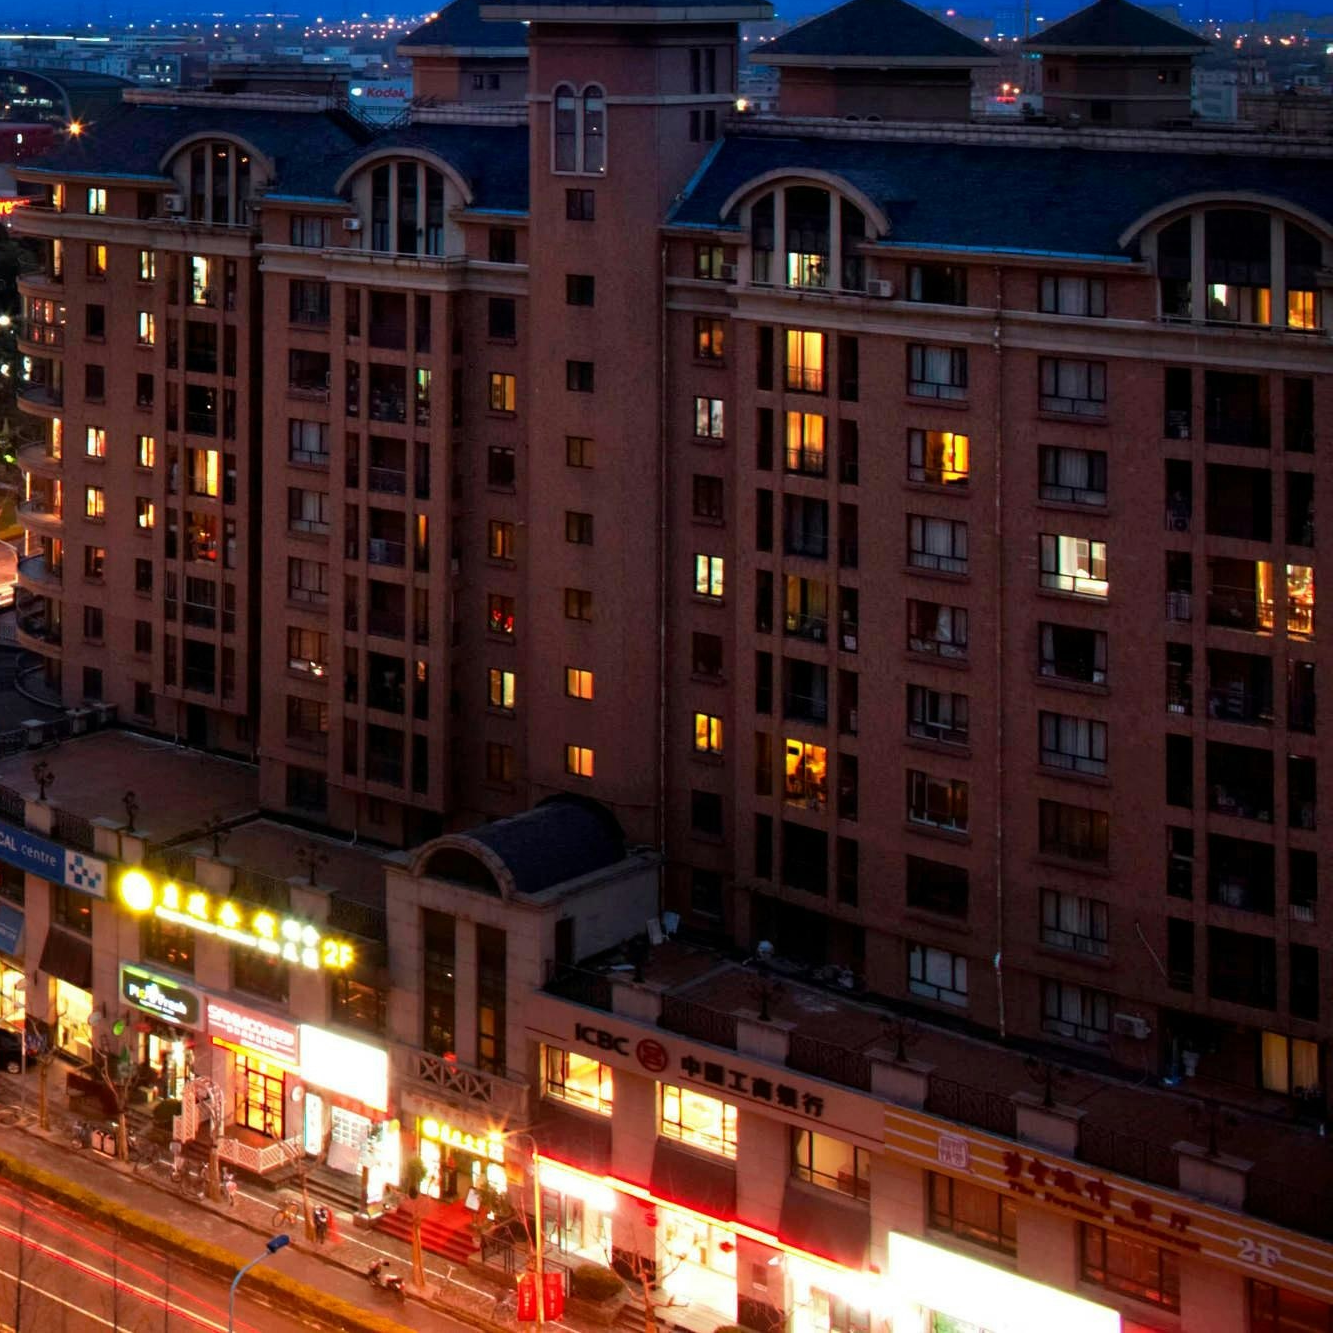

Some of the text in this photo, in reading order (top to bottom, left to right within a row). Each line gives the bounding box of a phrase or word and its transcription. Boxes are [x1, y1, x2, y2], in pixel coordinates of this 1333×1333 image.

[21, 843, 57, 867] centre
[323, 939, 354, 968] 2F
[574, 1023, 630, 1056] ICBC
[680, 1055, 824, 1117] 中国工商银行
[1237, 1237, 1282, 1266] 2F
